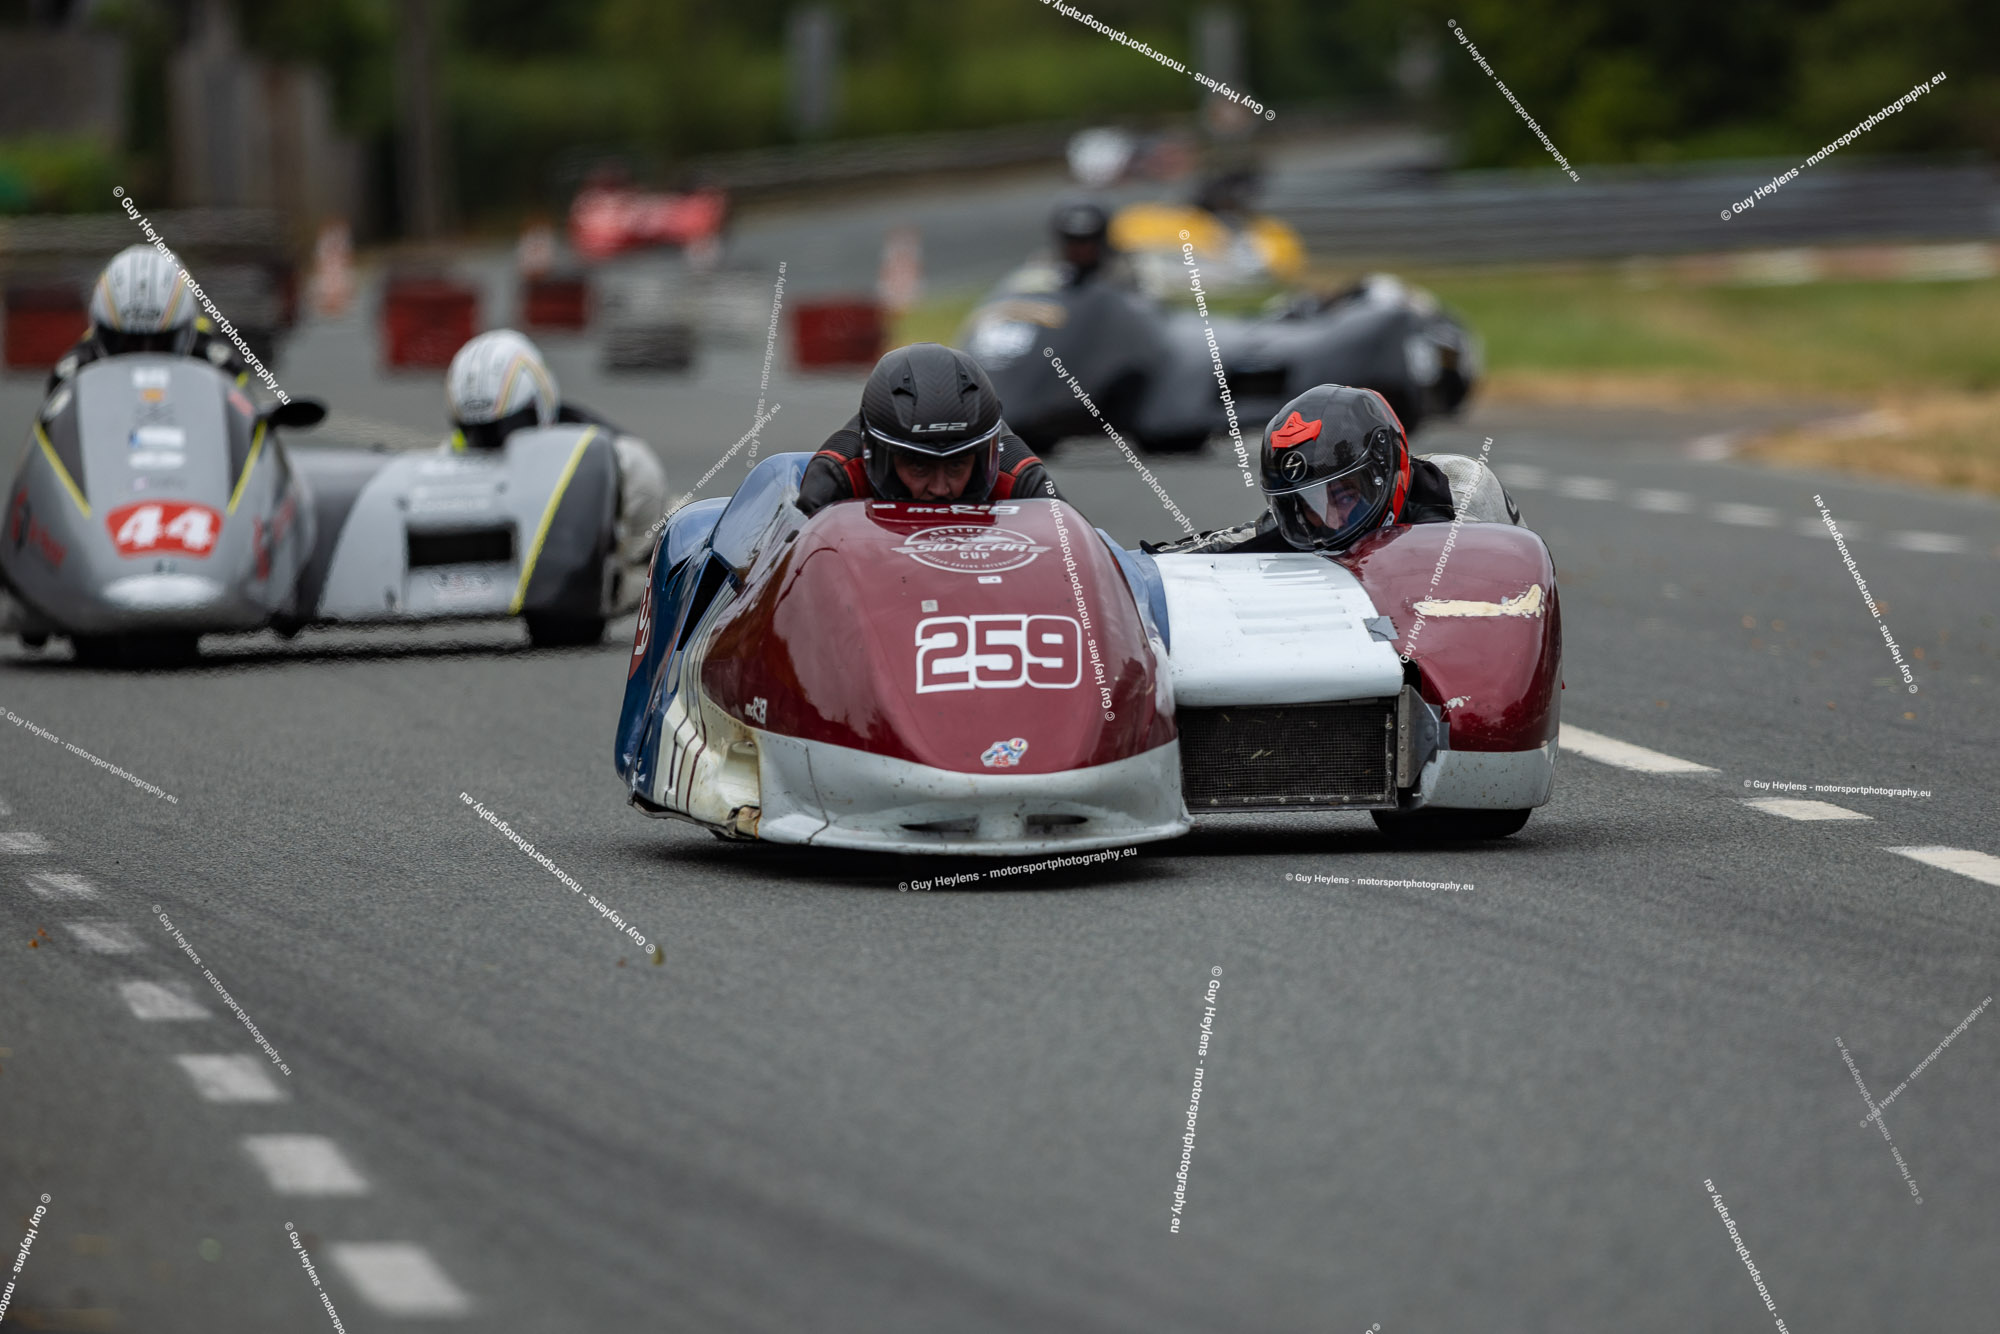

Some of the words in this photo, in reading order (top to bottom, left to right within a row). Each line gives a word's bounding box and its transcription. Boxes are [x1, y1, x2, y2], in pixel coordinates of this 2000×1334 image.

[911, 422, 968, 433] LS2
[117, 505, 212, 550] 44
[917, 543, 1027, 552] SIDECAR
[959, 551, 990, 560] CUP
[915, 614, 1082, 694] 259
